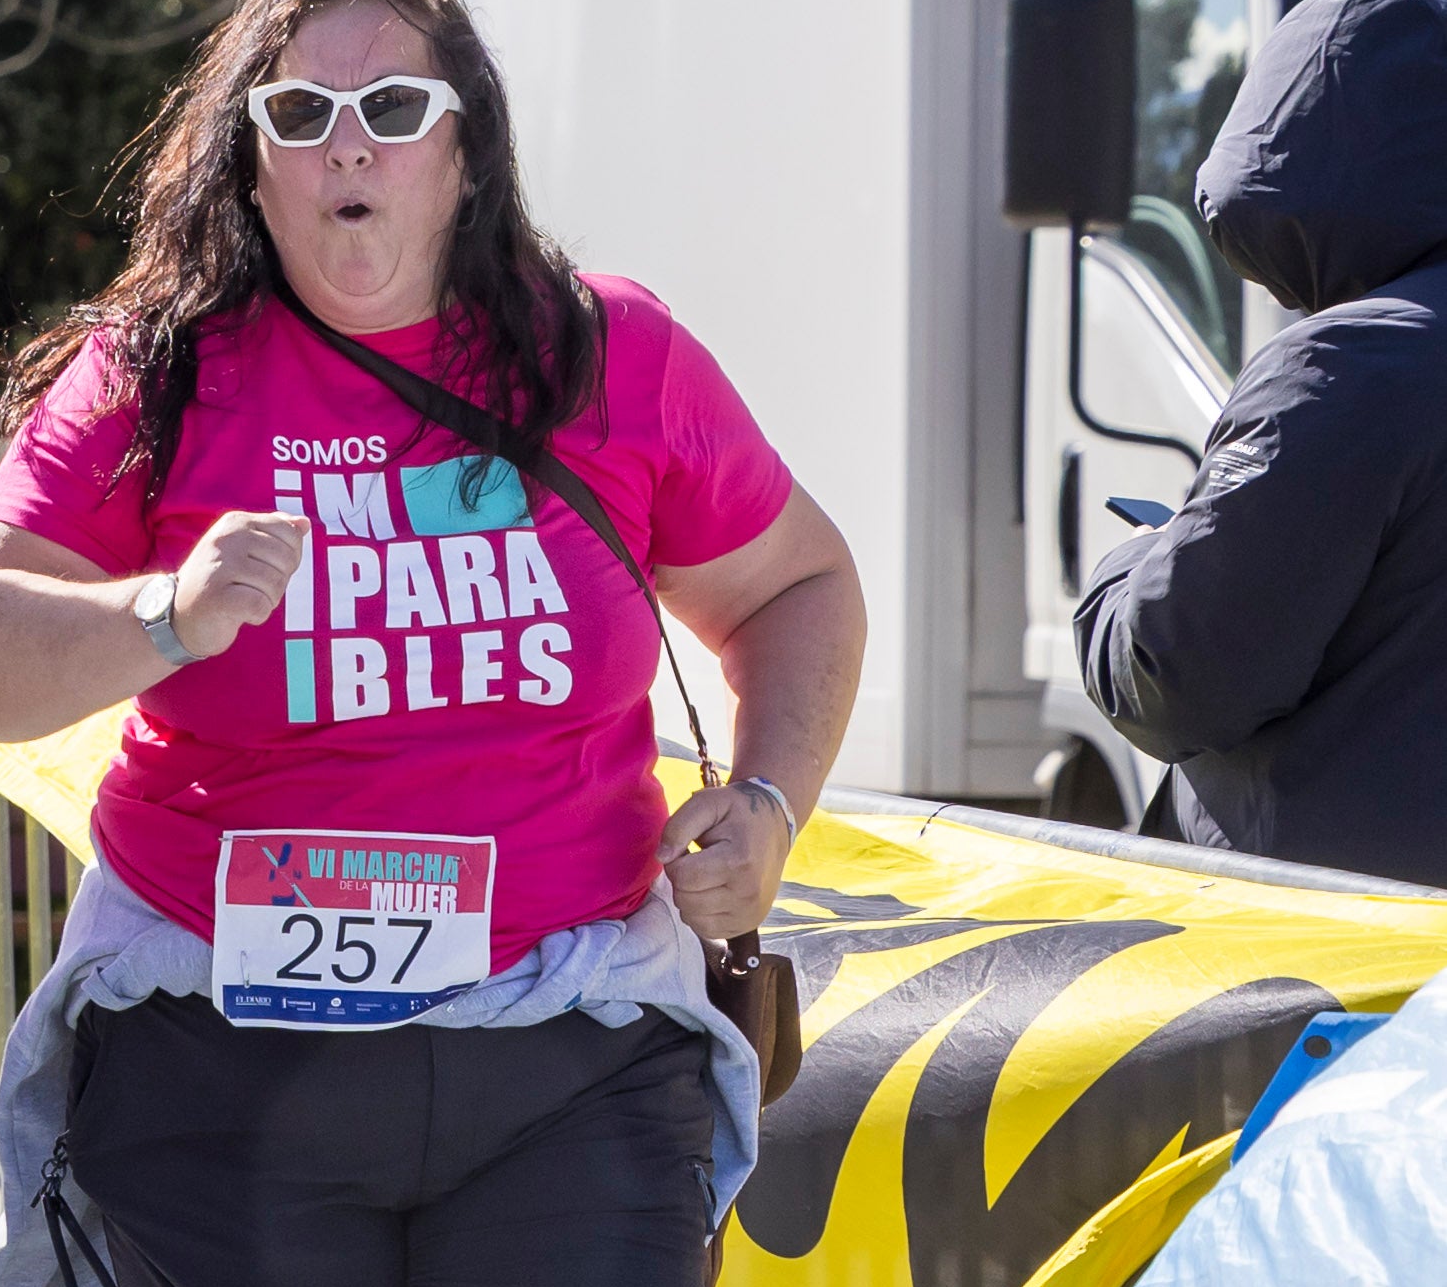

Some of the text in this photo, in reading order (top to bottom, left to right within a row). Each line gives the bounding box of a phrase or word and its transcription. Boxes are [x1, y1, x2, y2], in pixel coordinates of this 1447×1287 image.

[271, 435, 387, 465] SOMOS
[326, 530, 570, 631] PARA
[306, 849, 459, 884] VI MARCHA
[339, 881, 458, 914] DE LA MUJER
[275, 914, 433, 984] 257
